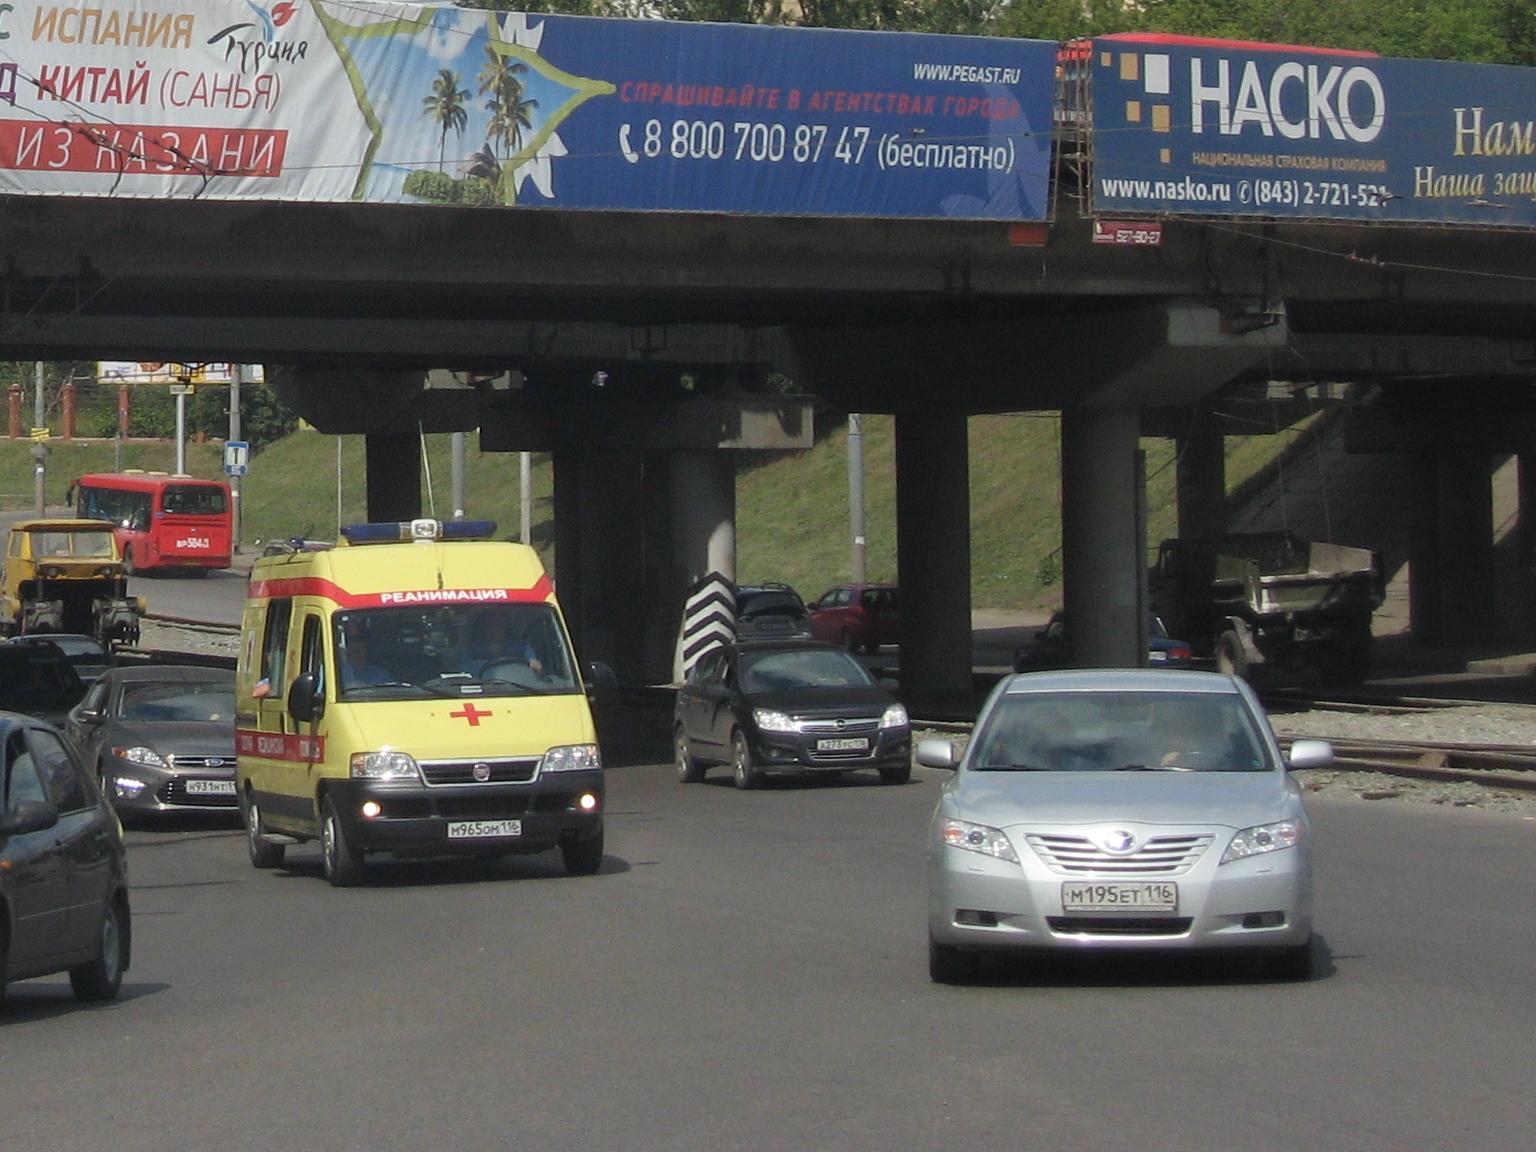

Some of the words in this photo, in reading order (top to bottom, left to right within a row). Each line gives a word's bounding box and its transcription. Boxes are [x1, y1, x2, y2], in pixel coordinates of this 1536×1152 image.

[31, 6, 195, 49] ИСПАНИЯ
[37, 60, 151, 106] КИТАЙ
[160, 68, 281, 114] (САНЬЯ)
[914, 64, 1020, 84] WWW.PEGAST.RU
[621, 80, 781, 109] СПРАШИВАЙТЕ
[788, 88, 802, 110] В
[810, 90, 937, 115] АГЕНТСТВАХ
[943, 96, 1021, 120] ГОРОДА
[1191, 57, 1386, 143] НАСКО
[15, 127, 74, 169] ИЗ
[95, 130, 275, 176] КАЗАНИ
[644, 119, 662, 158] 8
[670, 120, 725, 160] 800
[734, 122, 786, 162] 700
[793, 124, 828, 163] 87
[834, 126, 871, 164] 47
[877, 133, 1015, 174] (бесплатно)
[1453, 107, 1535, 157] Нам
[1192, 152, 1274, 168] НАЦИОНАЛЬНАЯ
[1275, 154, 1330, 170] СТРАХОВАЯ
[1101, 176, 1231, 202] www.nasko.ru
[1254, 178, 1299, 208] (843)
[1413, 166, 1484, 198] Наша
[381, 588, 508, 605] РЕАНИМАЦИЯ
